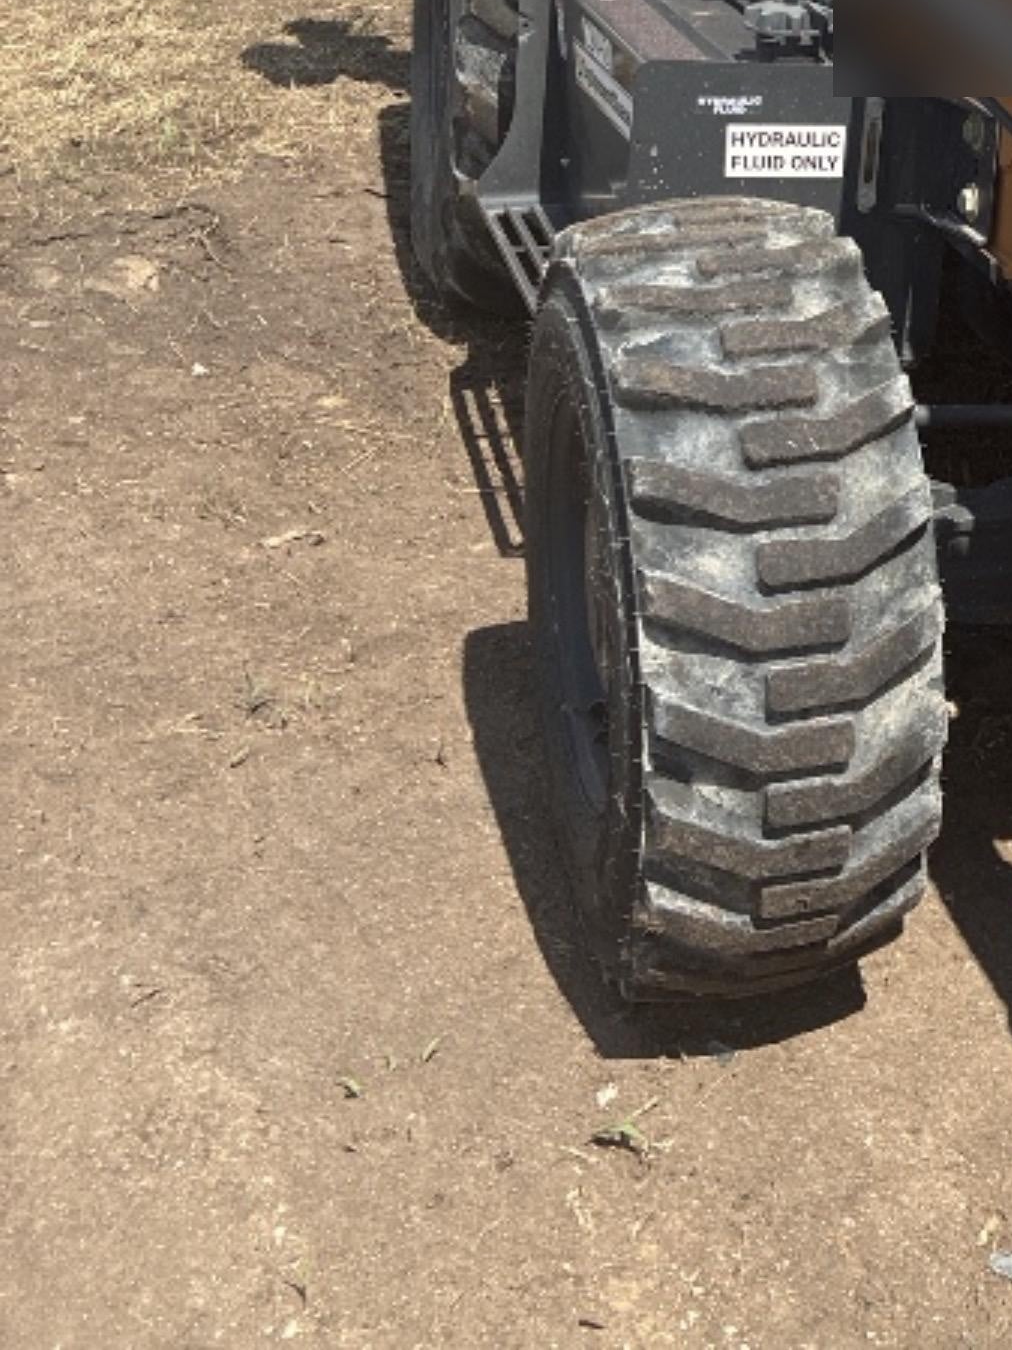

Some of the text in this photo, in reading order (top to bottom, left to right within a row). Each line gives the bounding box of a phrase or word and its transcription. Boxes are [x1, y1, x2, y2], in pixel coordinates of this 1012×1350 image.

[731, 131, 841, 148] HYDRAULIC
[731, 154, 839, 171] FLUID ONLY
